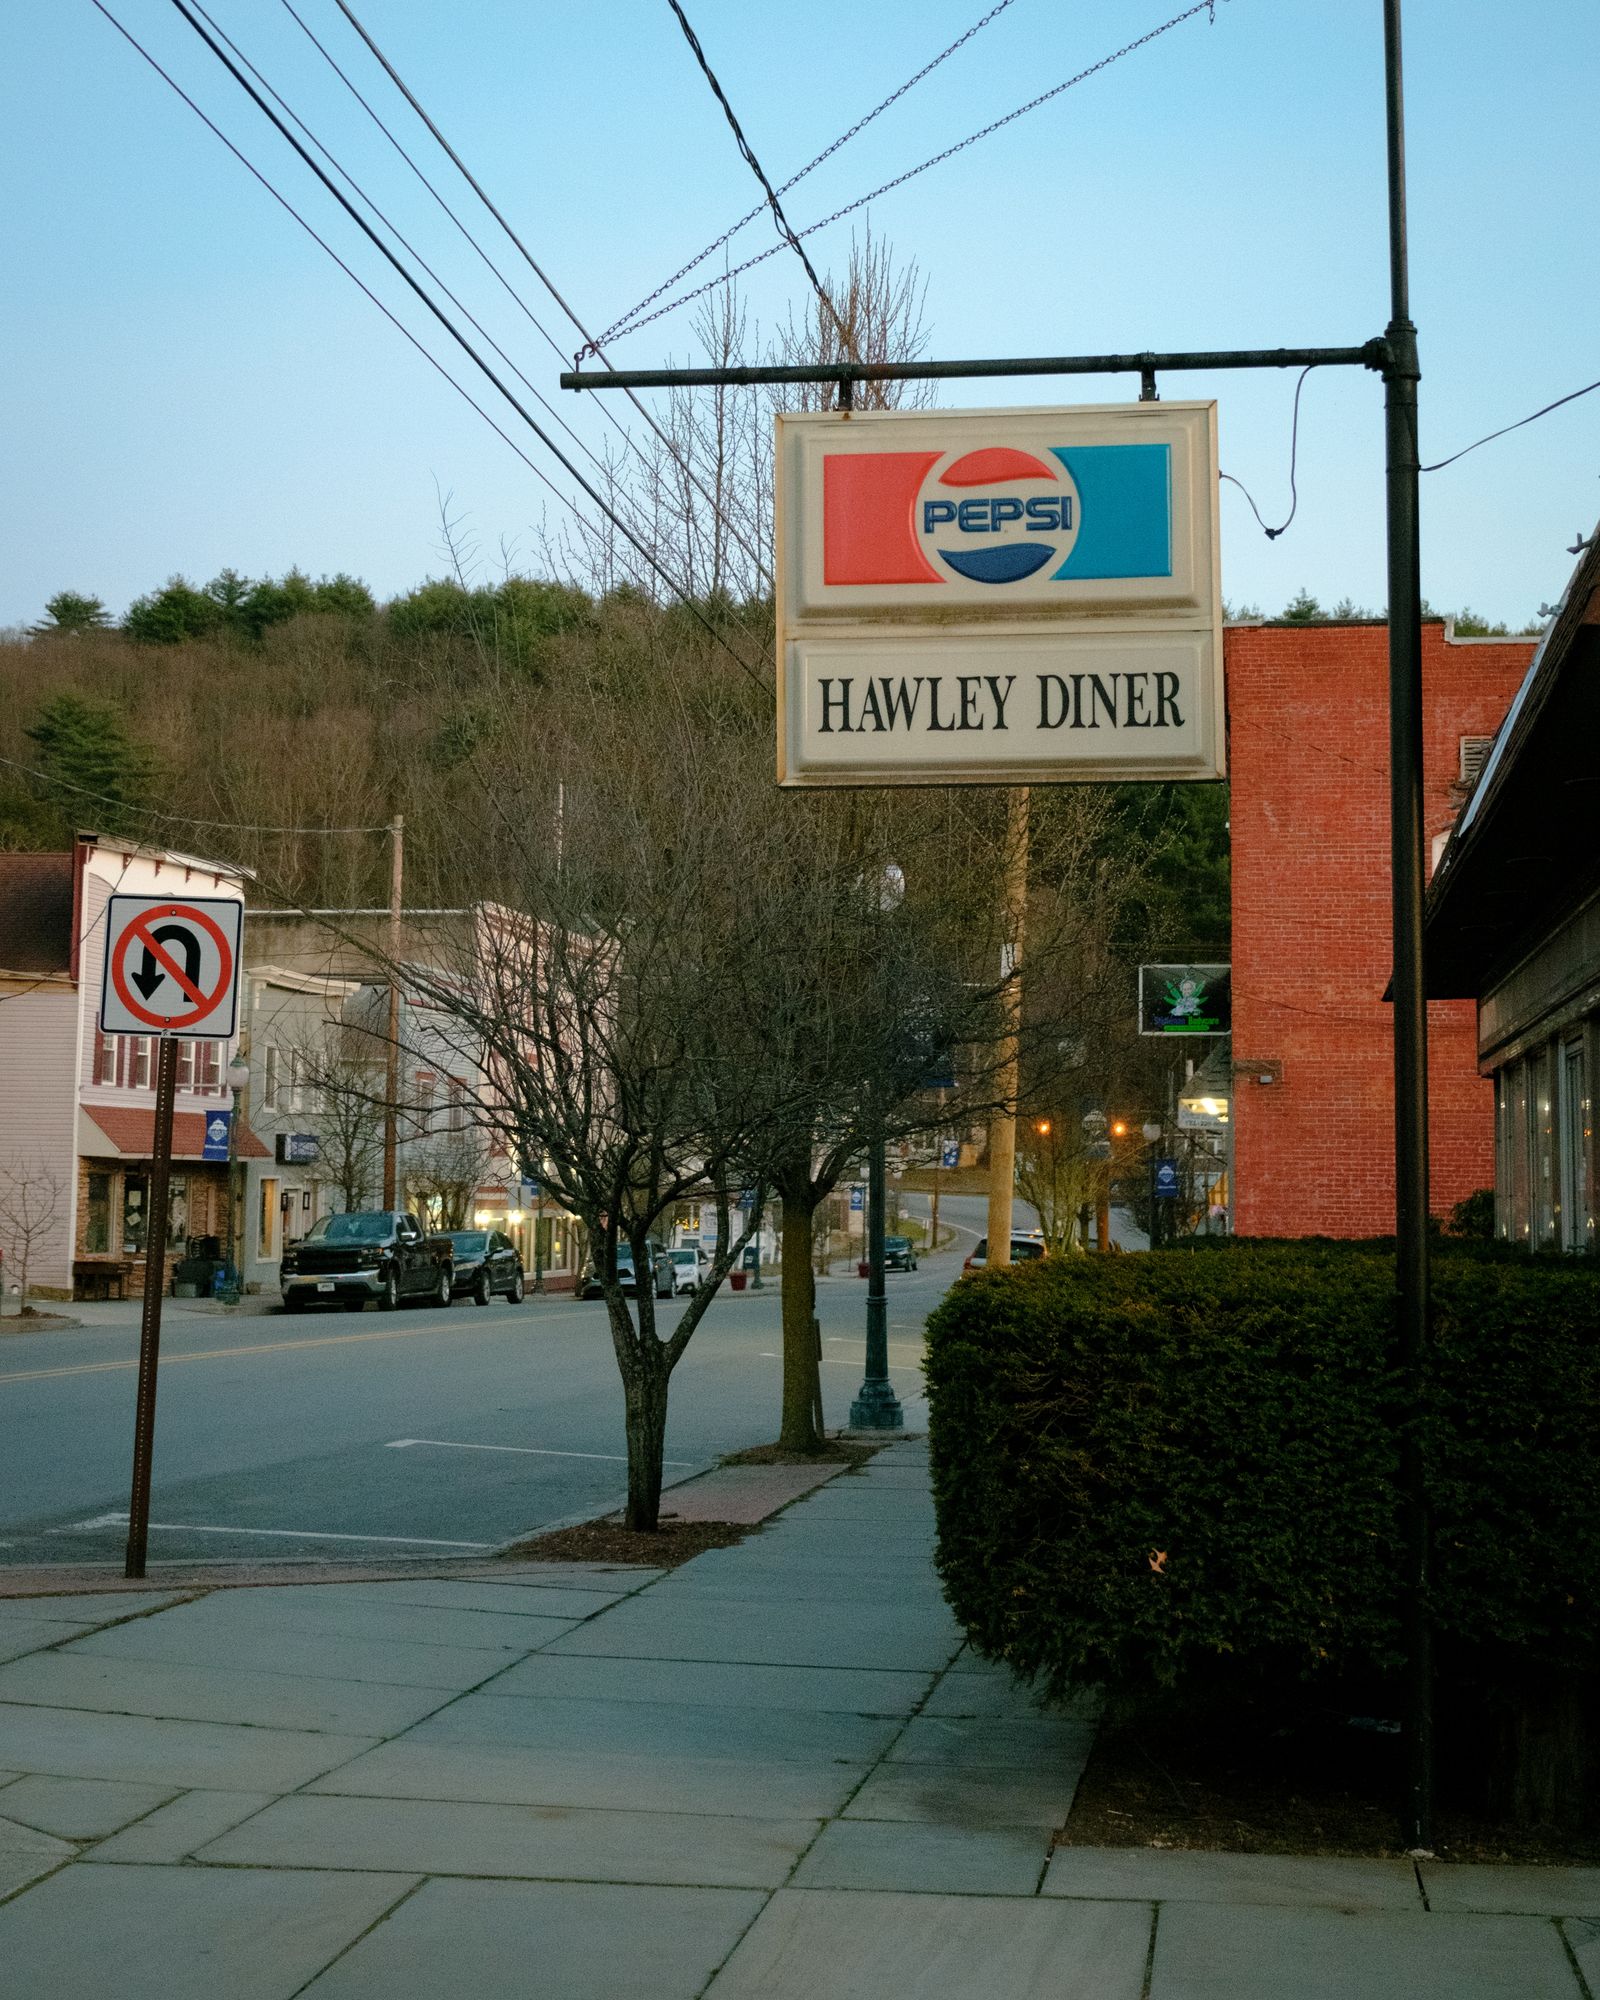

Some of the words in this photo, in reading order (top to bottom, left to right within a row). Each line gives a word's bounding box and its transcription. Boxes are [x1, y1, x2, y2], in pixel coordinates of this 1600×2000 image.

[924, 496, 1072, 534] PEPSI
[818, 675, 1016, 732] HAWLEY
[1035, 671, 1186, 730] DINER
